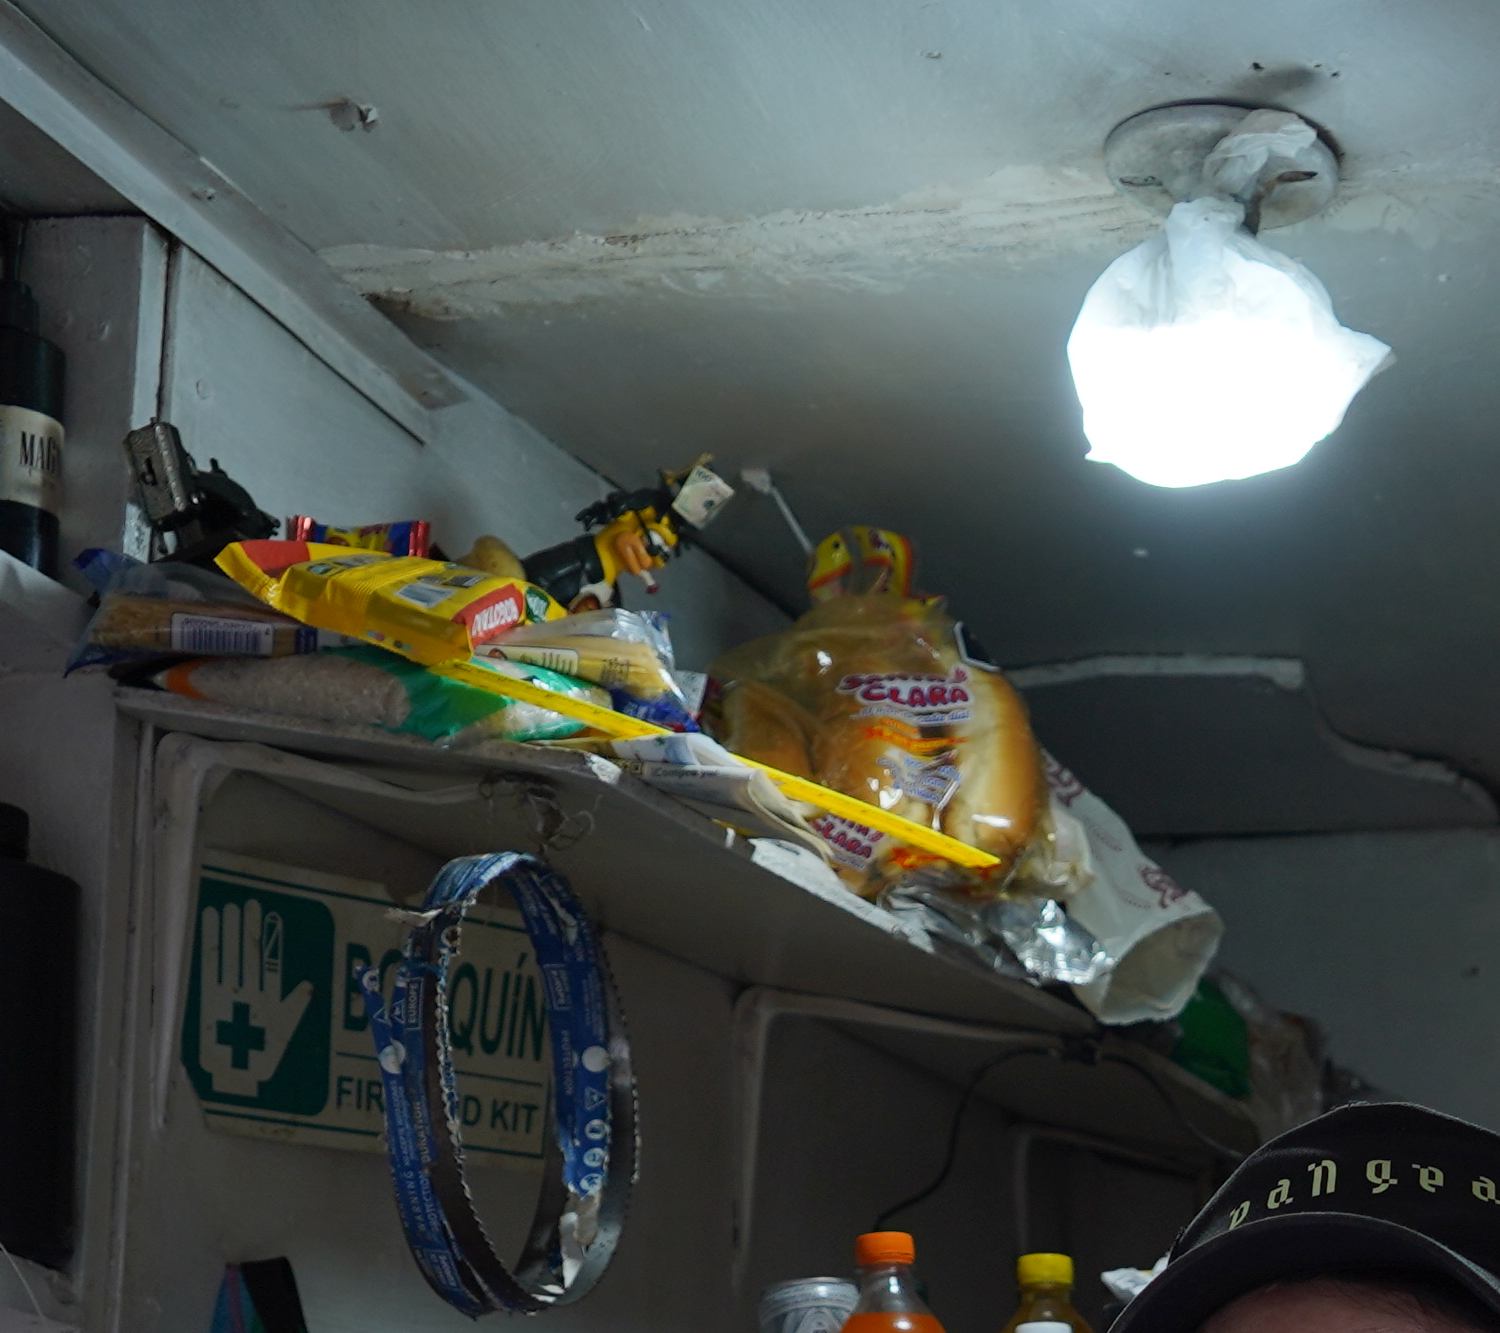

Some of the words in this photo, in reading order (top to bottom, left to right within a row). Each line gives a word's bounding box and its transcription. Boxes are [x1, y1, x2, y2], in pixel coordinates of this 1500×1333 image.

[861, 684, 970, 707] CLARA
[407, 981, 421, 1024] EUROPE
[491, 1099, 540, 1135] KIT
